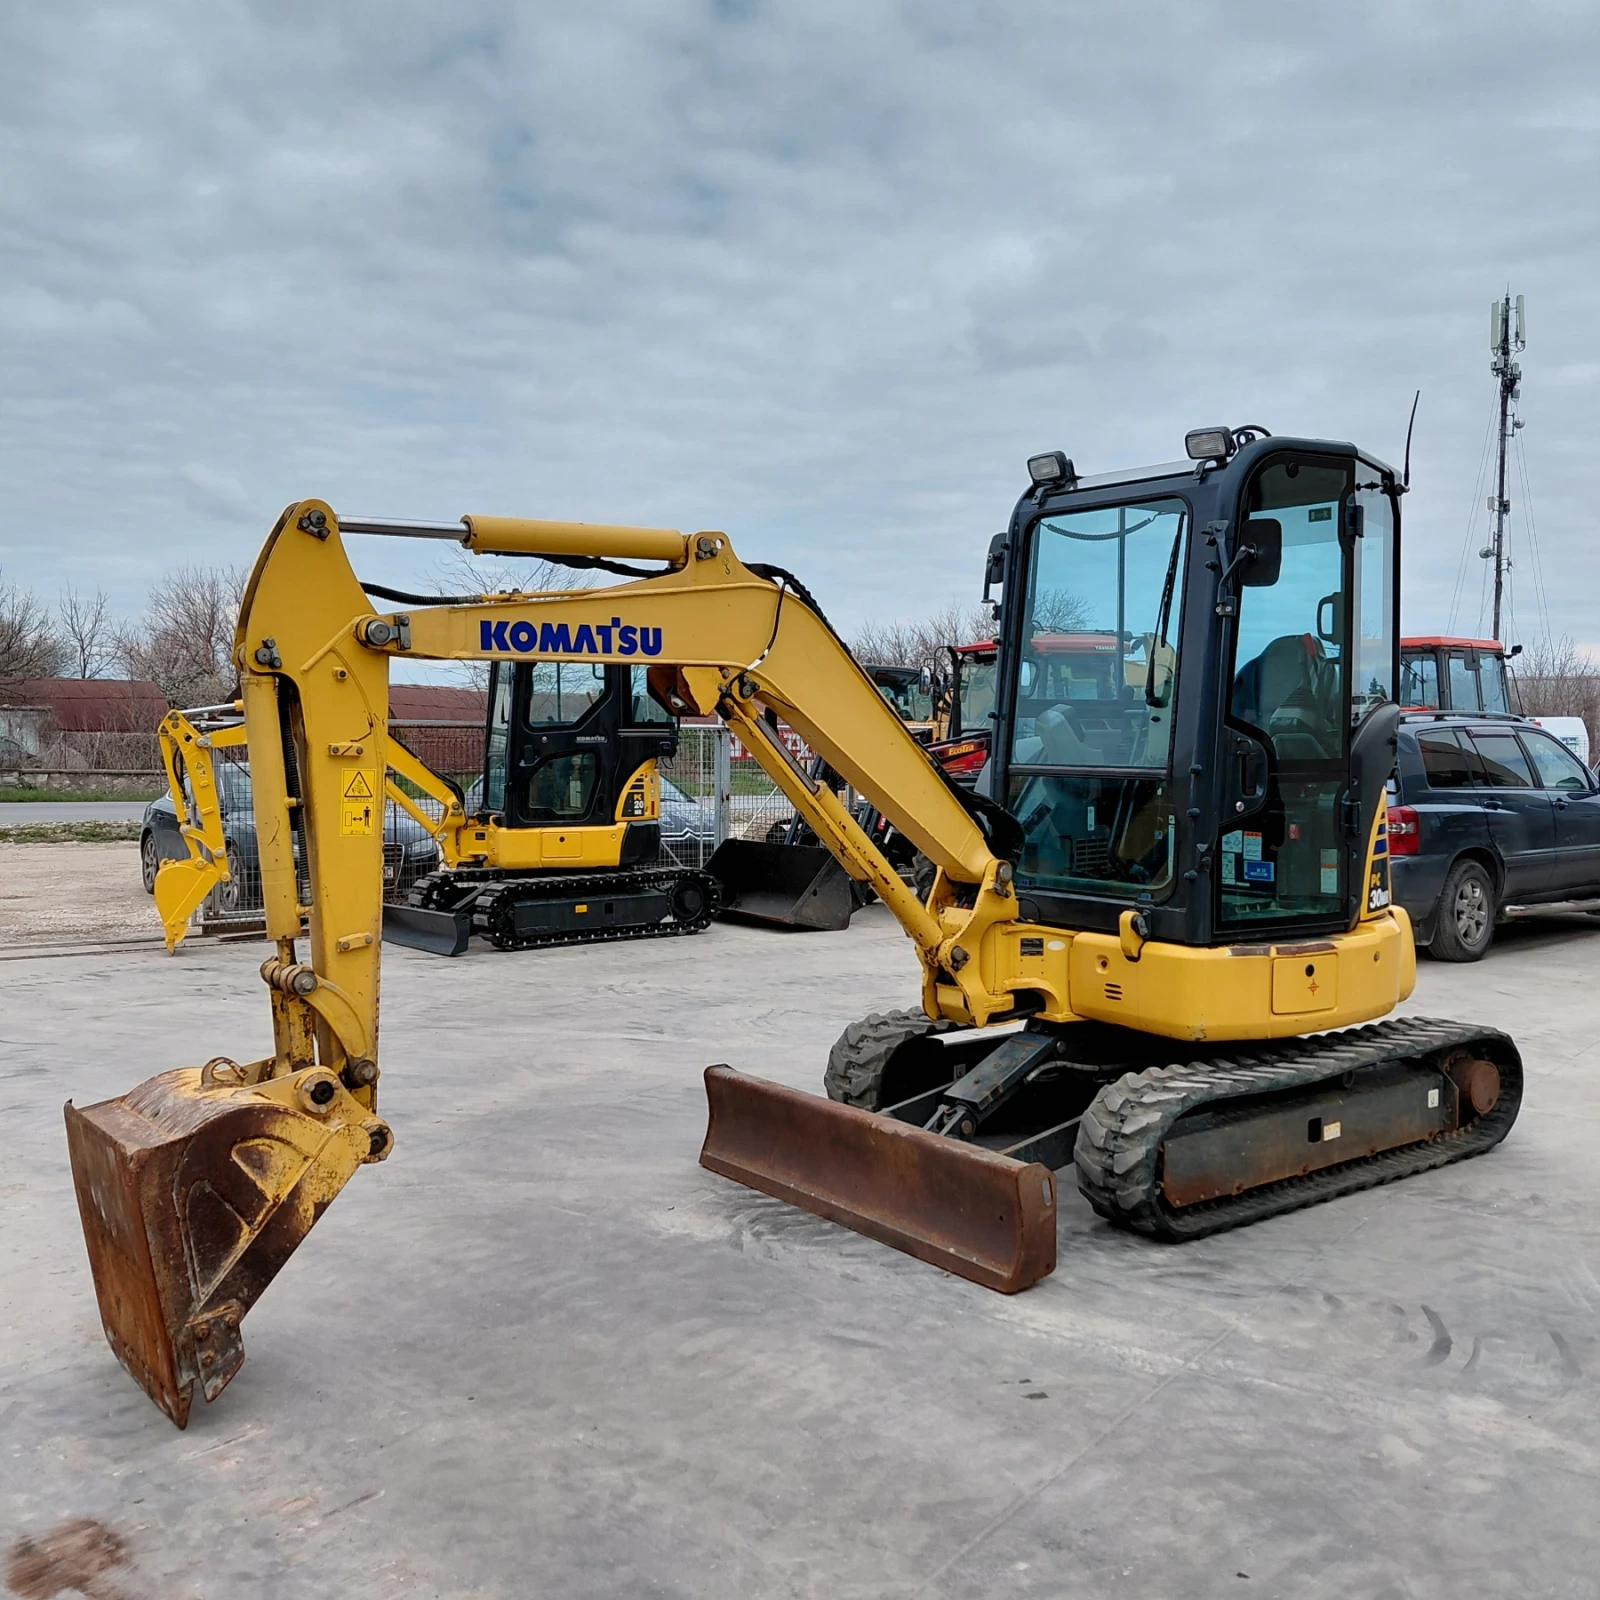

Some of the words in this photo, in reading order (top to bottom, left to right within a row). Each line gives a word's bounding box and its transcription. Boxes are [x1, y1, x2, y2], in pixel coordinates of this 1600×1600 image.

[480, 617, 662, 656] KOMATSU
[948, 744, 975, 756] EcoTra
[634, 800, 644, 809] 20
[1370, 872, 1381, 888] PC
